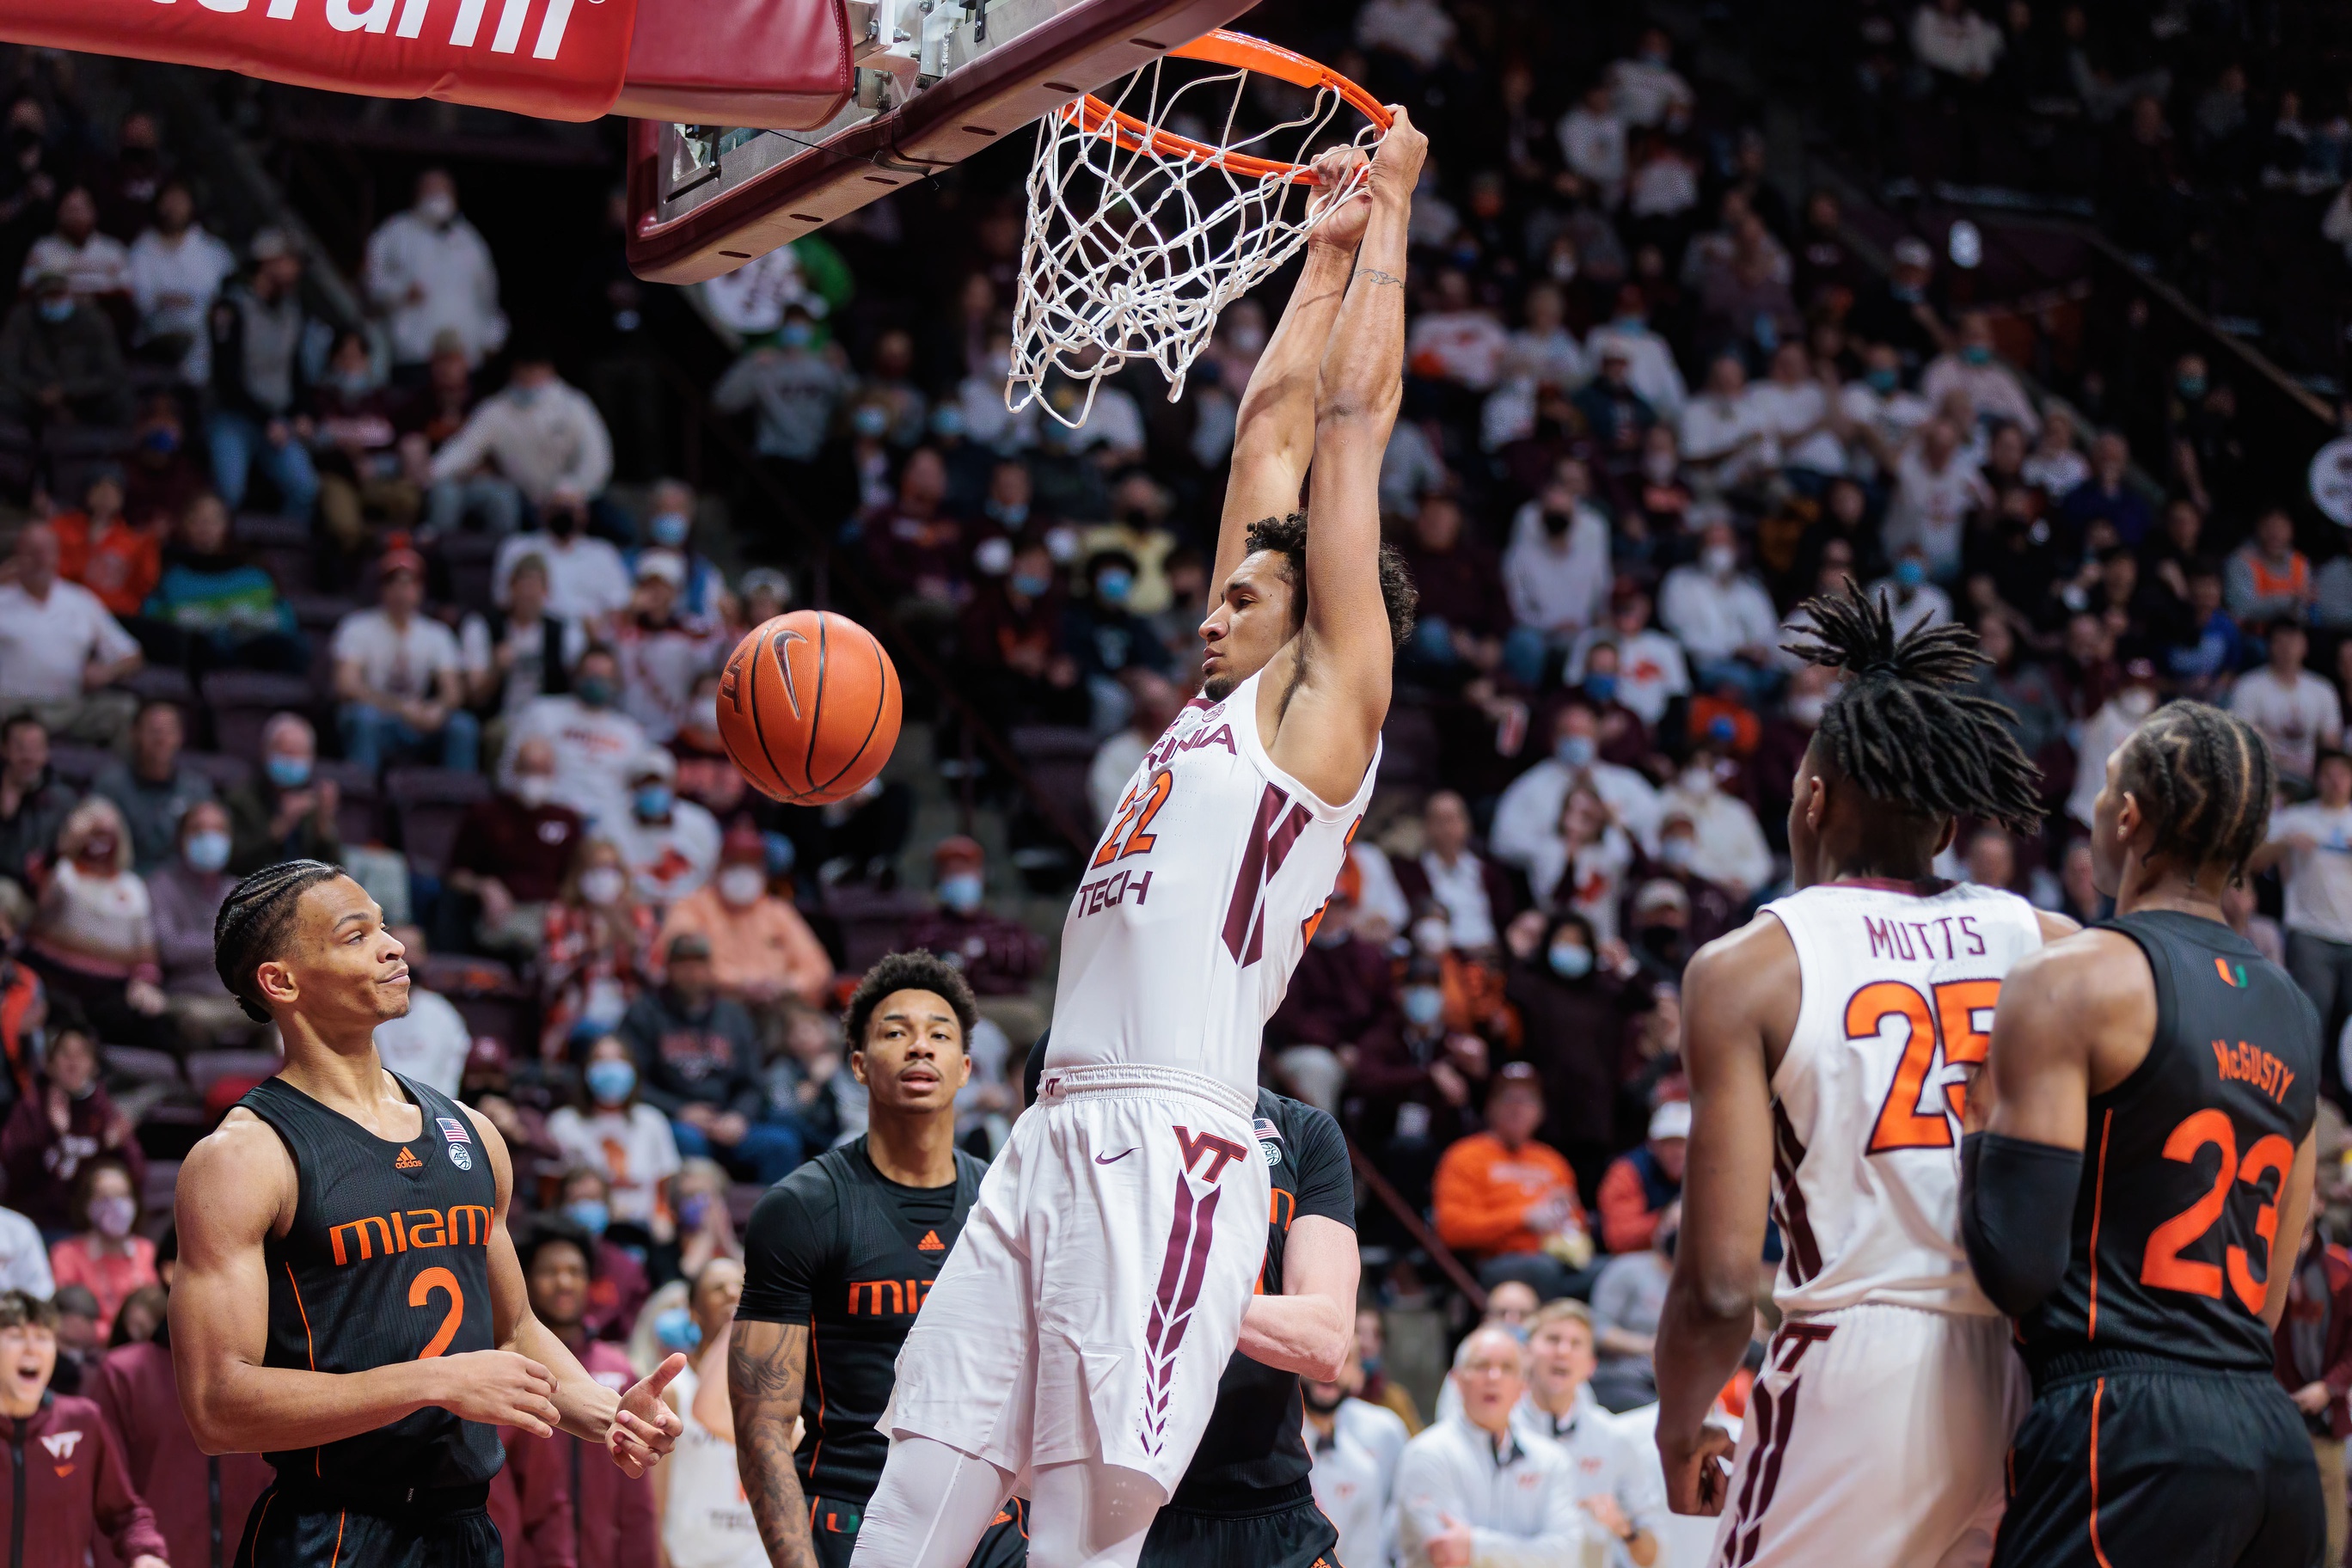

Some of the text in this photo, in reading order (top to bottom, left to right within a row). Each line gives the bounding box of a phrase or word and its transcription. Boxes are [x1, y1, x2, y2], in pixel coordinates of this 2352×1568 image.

[1090, 769, 1173, 870] 22
[1077, 869, 1154, 918] TECH
[1862, 915, 1987, 960] MUTTS
[395, 1159, 423, 1169] adidas
[454, 1152, 468, 1161] ACC
[1172, 1125, 1248, 1185] VT
[2140, 1107, 2295, 1315] 23
[408, 1266, 464, 1361] 2
[40, 1430, 83, 1459] VT
